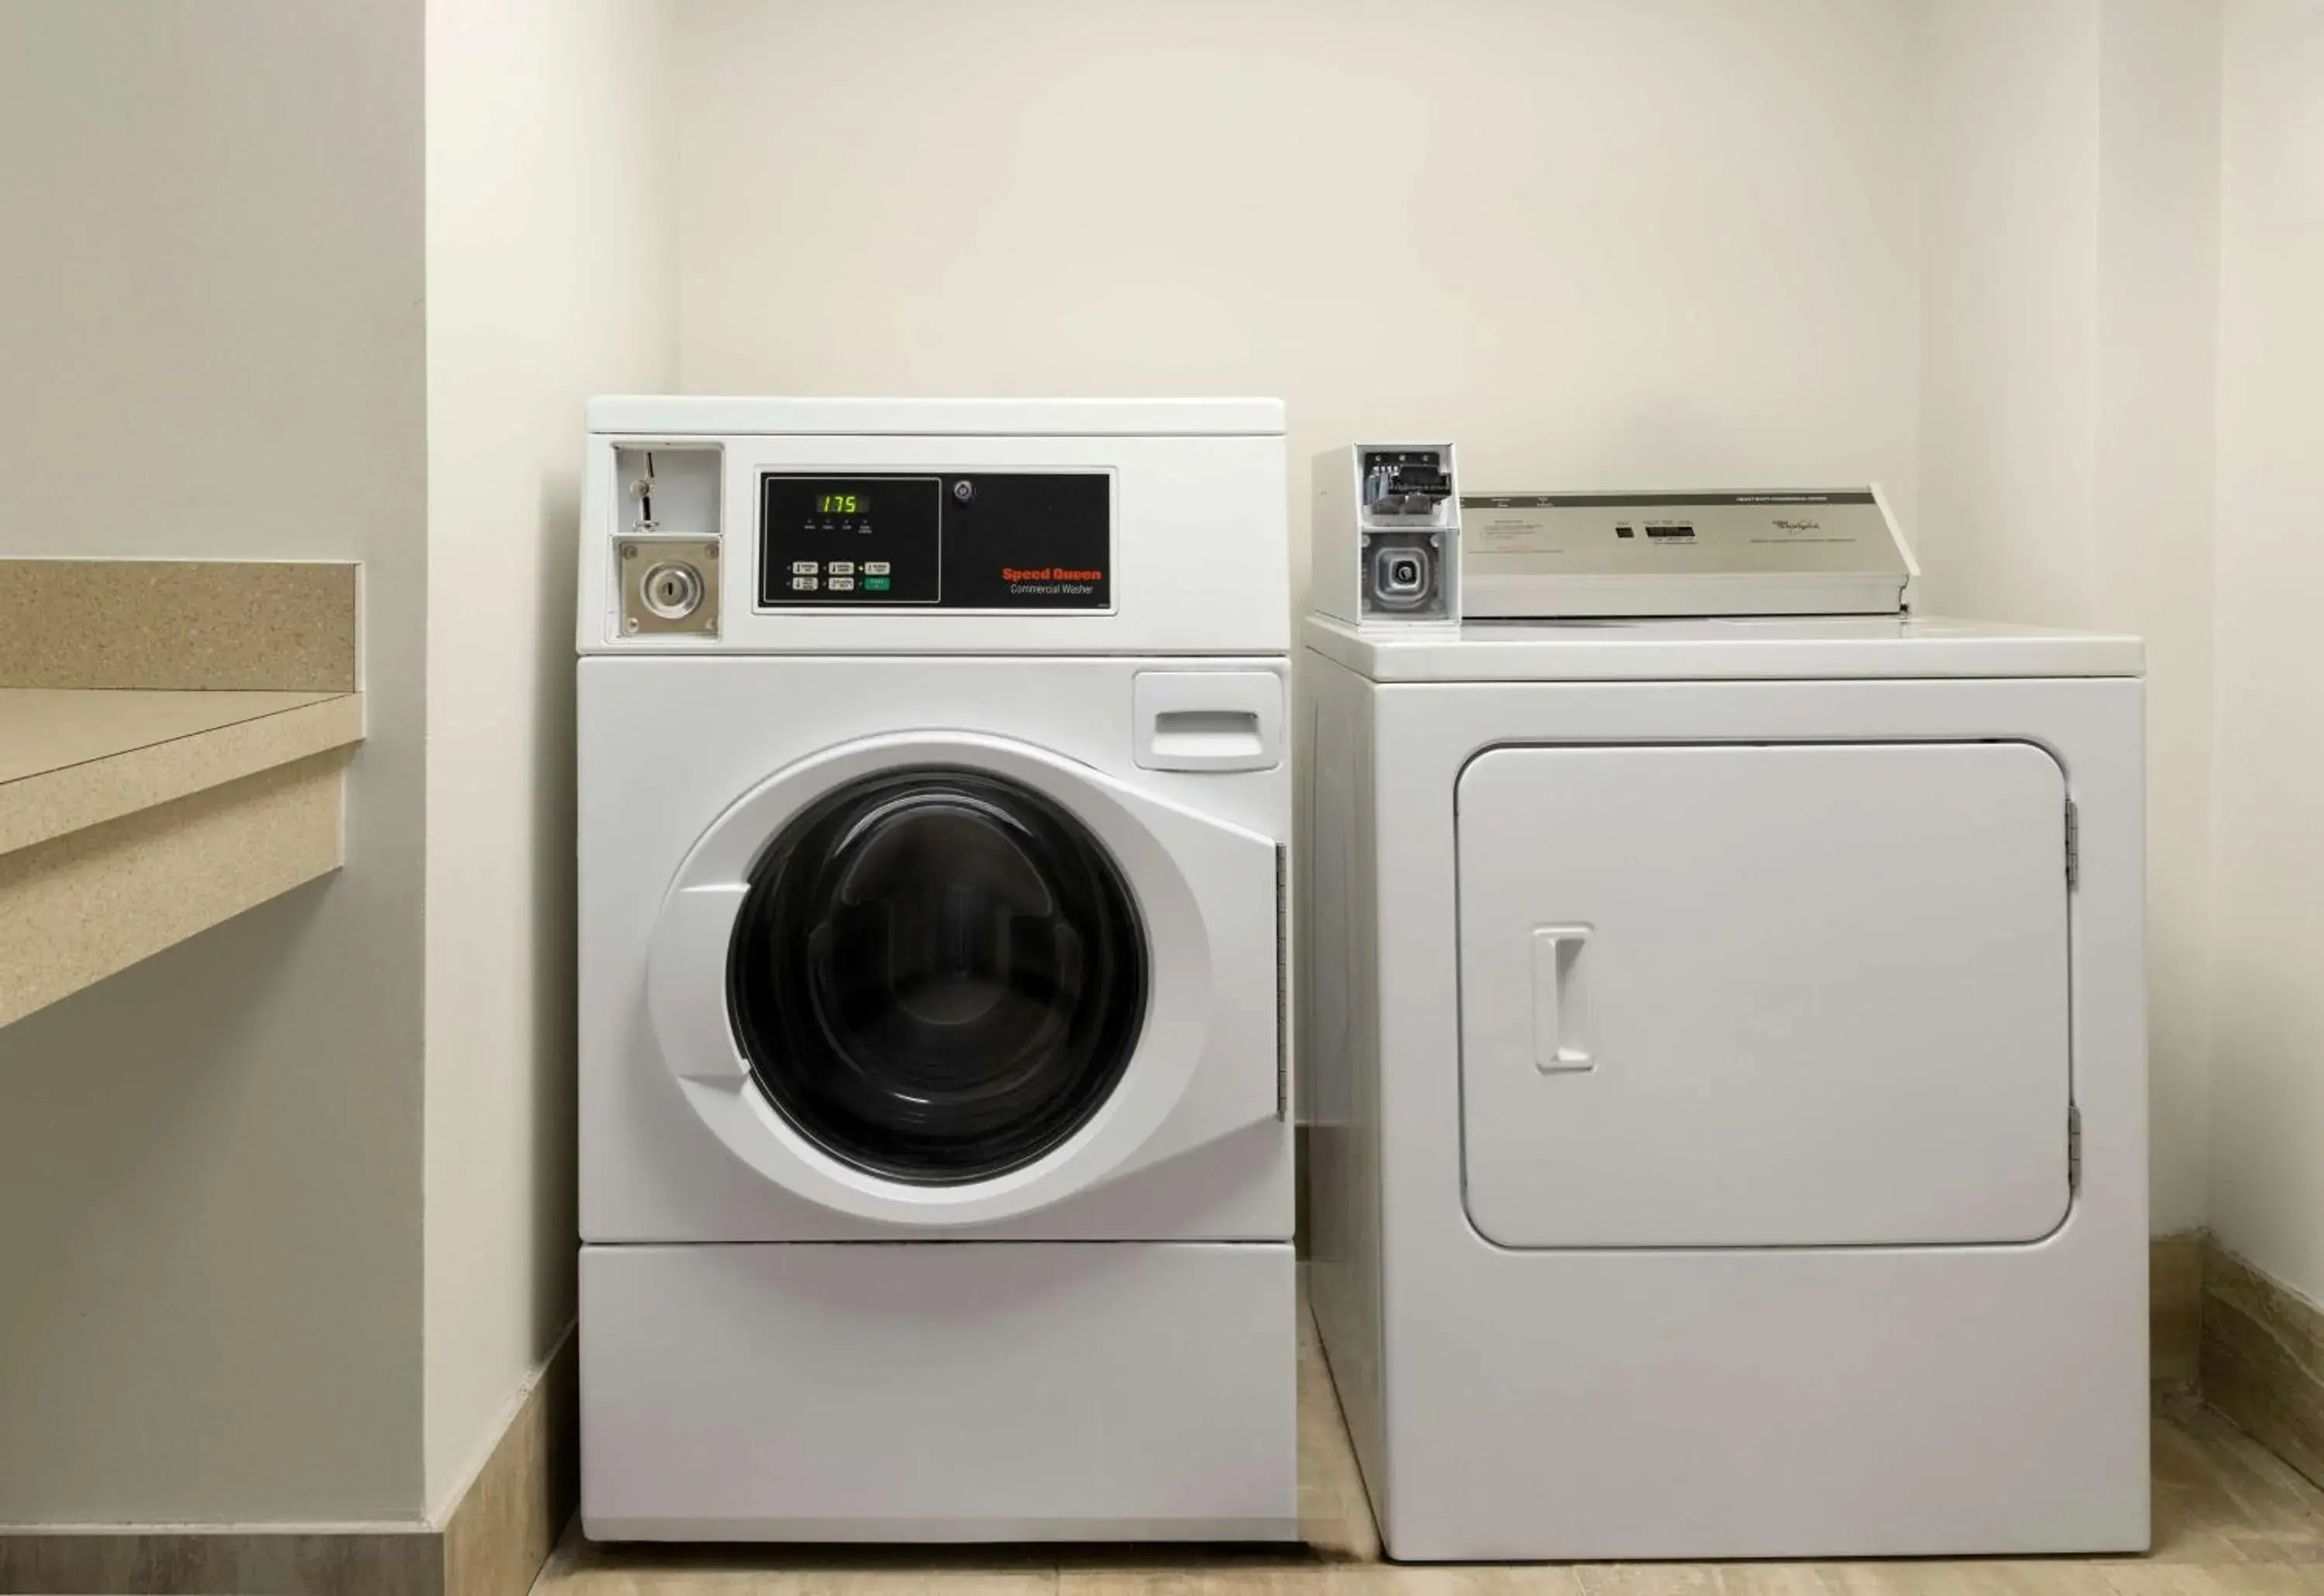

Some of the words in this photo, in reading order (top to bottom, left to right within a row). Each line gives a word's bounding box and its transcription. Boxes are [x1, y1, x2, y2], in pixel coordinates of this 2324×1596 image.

[823, 495, 856, 513] 175
[1002, 568, 1050, 582] Speed
[1054, 568, 1102, 580] Queen
[1010, 584, 1061, 594] Commercial
[1062, 584, 1093, 594] Washer
